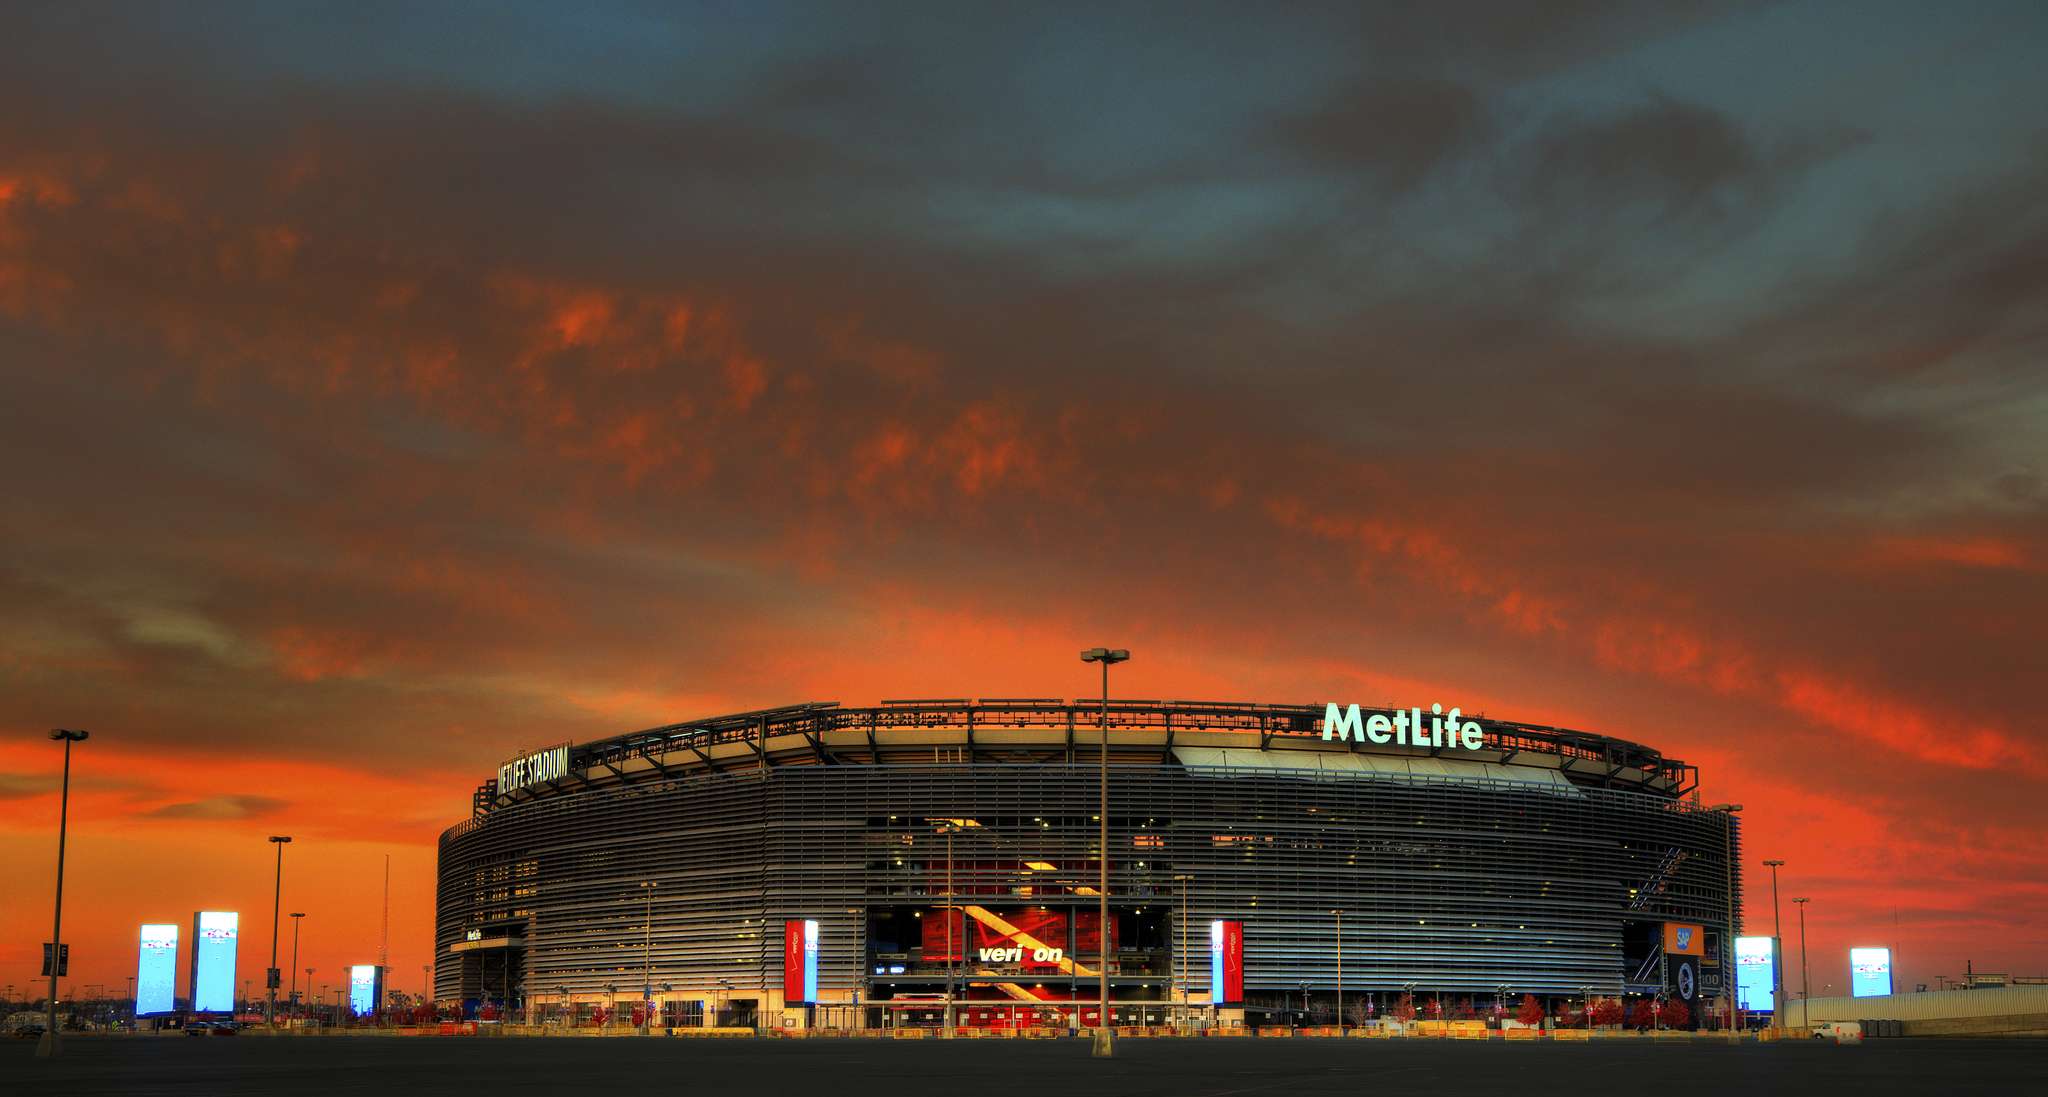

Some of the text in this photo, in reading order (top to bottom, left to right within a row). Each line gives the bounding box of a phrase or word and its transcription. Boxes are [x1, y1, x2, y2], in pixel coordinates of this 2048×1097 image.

[1322, 702, 1483, 750] MetLife
[497, 745, 569, 797] METLIFE STADIUM
